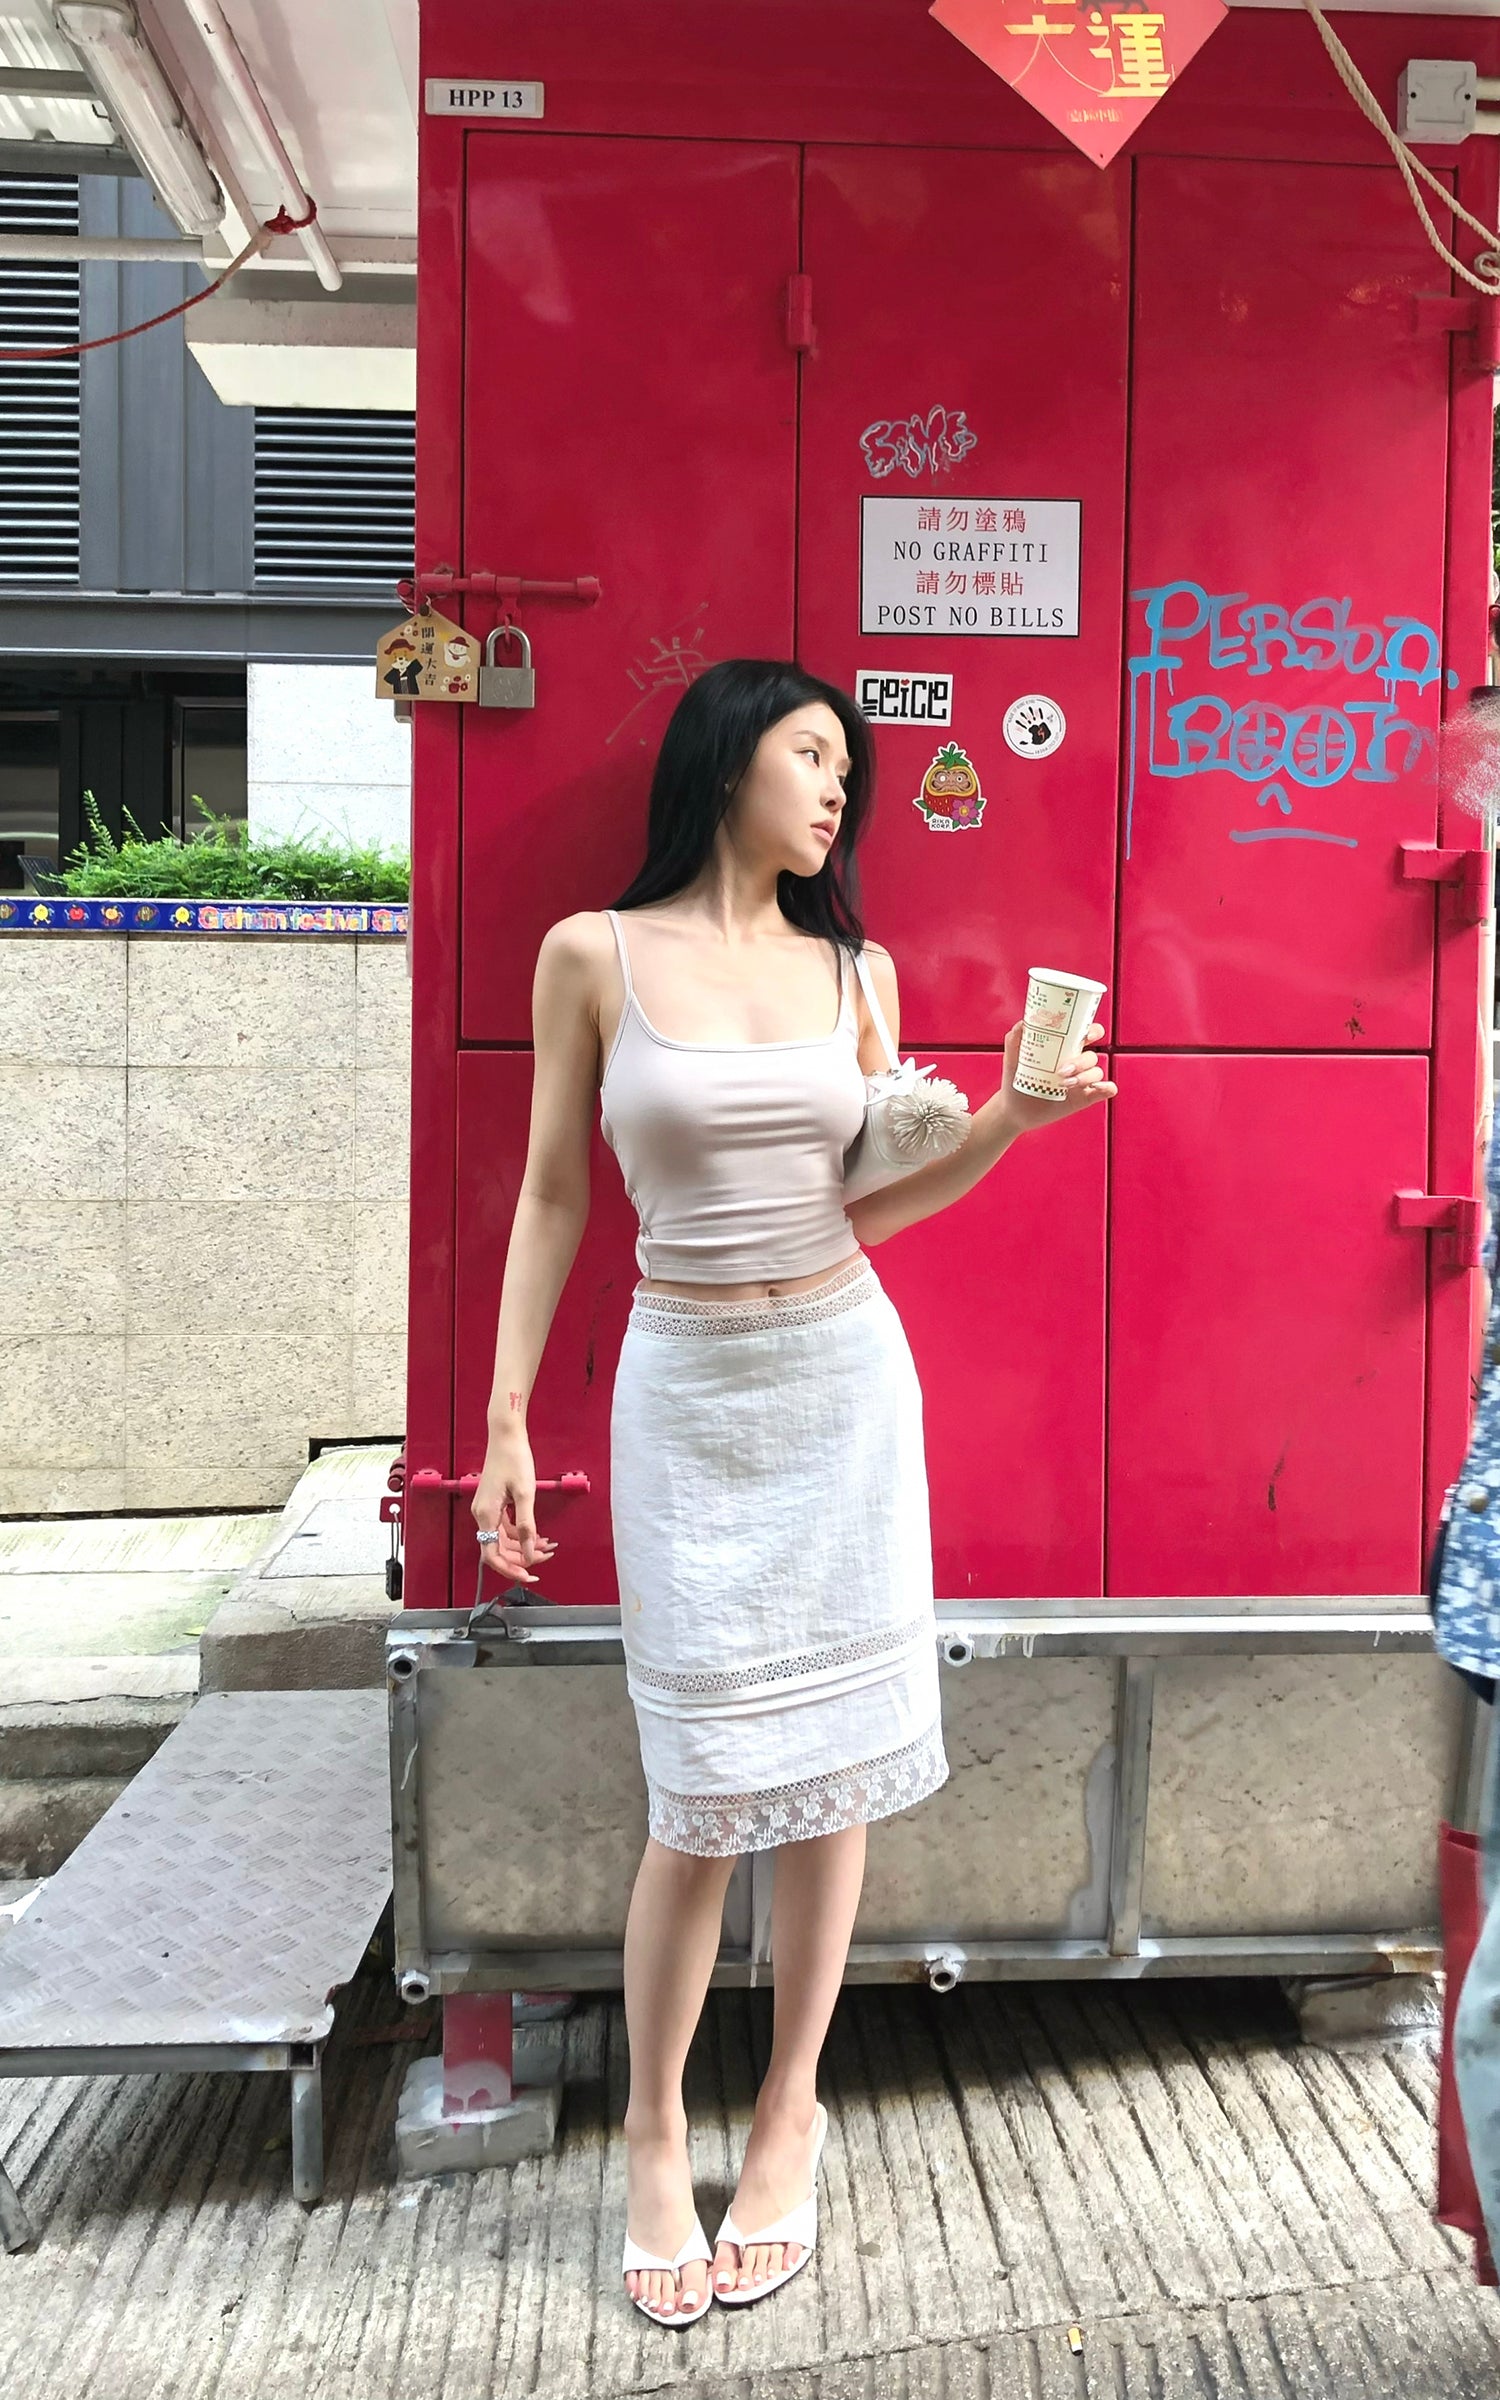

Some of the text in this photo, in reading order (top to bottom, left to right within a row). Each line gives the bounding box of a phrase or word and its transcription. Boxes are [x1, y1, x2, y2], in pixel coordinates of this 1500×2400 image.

[449, 88, 523, 109] HPP 13
[917, 506, 1026, 533] 請勿塗鴉
[893, 541, 1048, 563] NO GRAFFITI
[916, 570, 1024, 596] 請勿標貼
[878, 605, 1064, 628] POST NO BILLS
